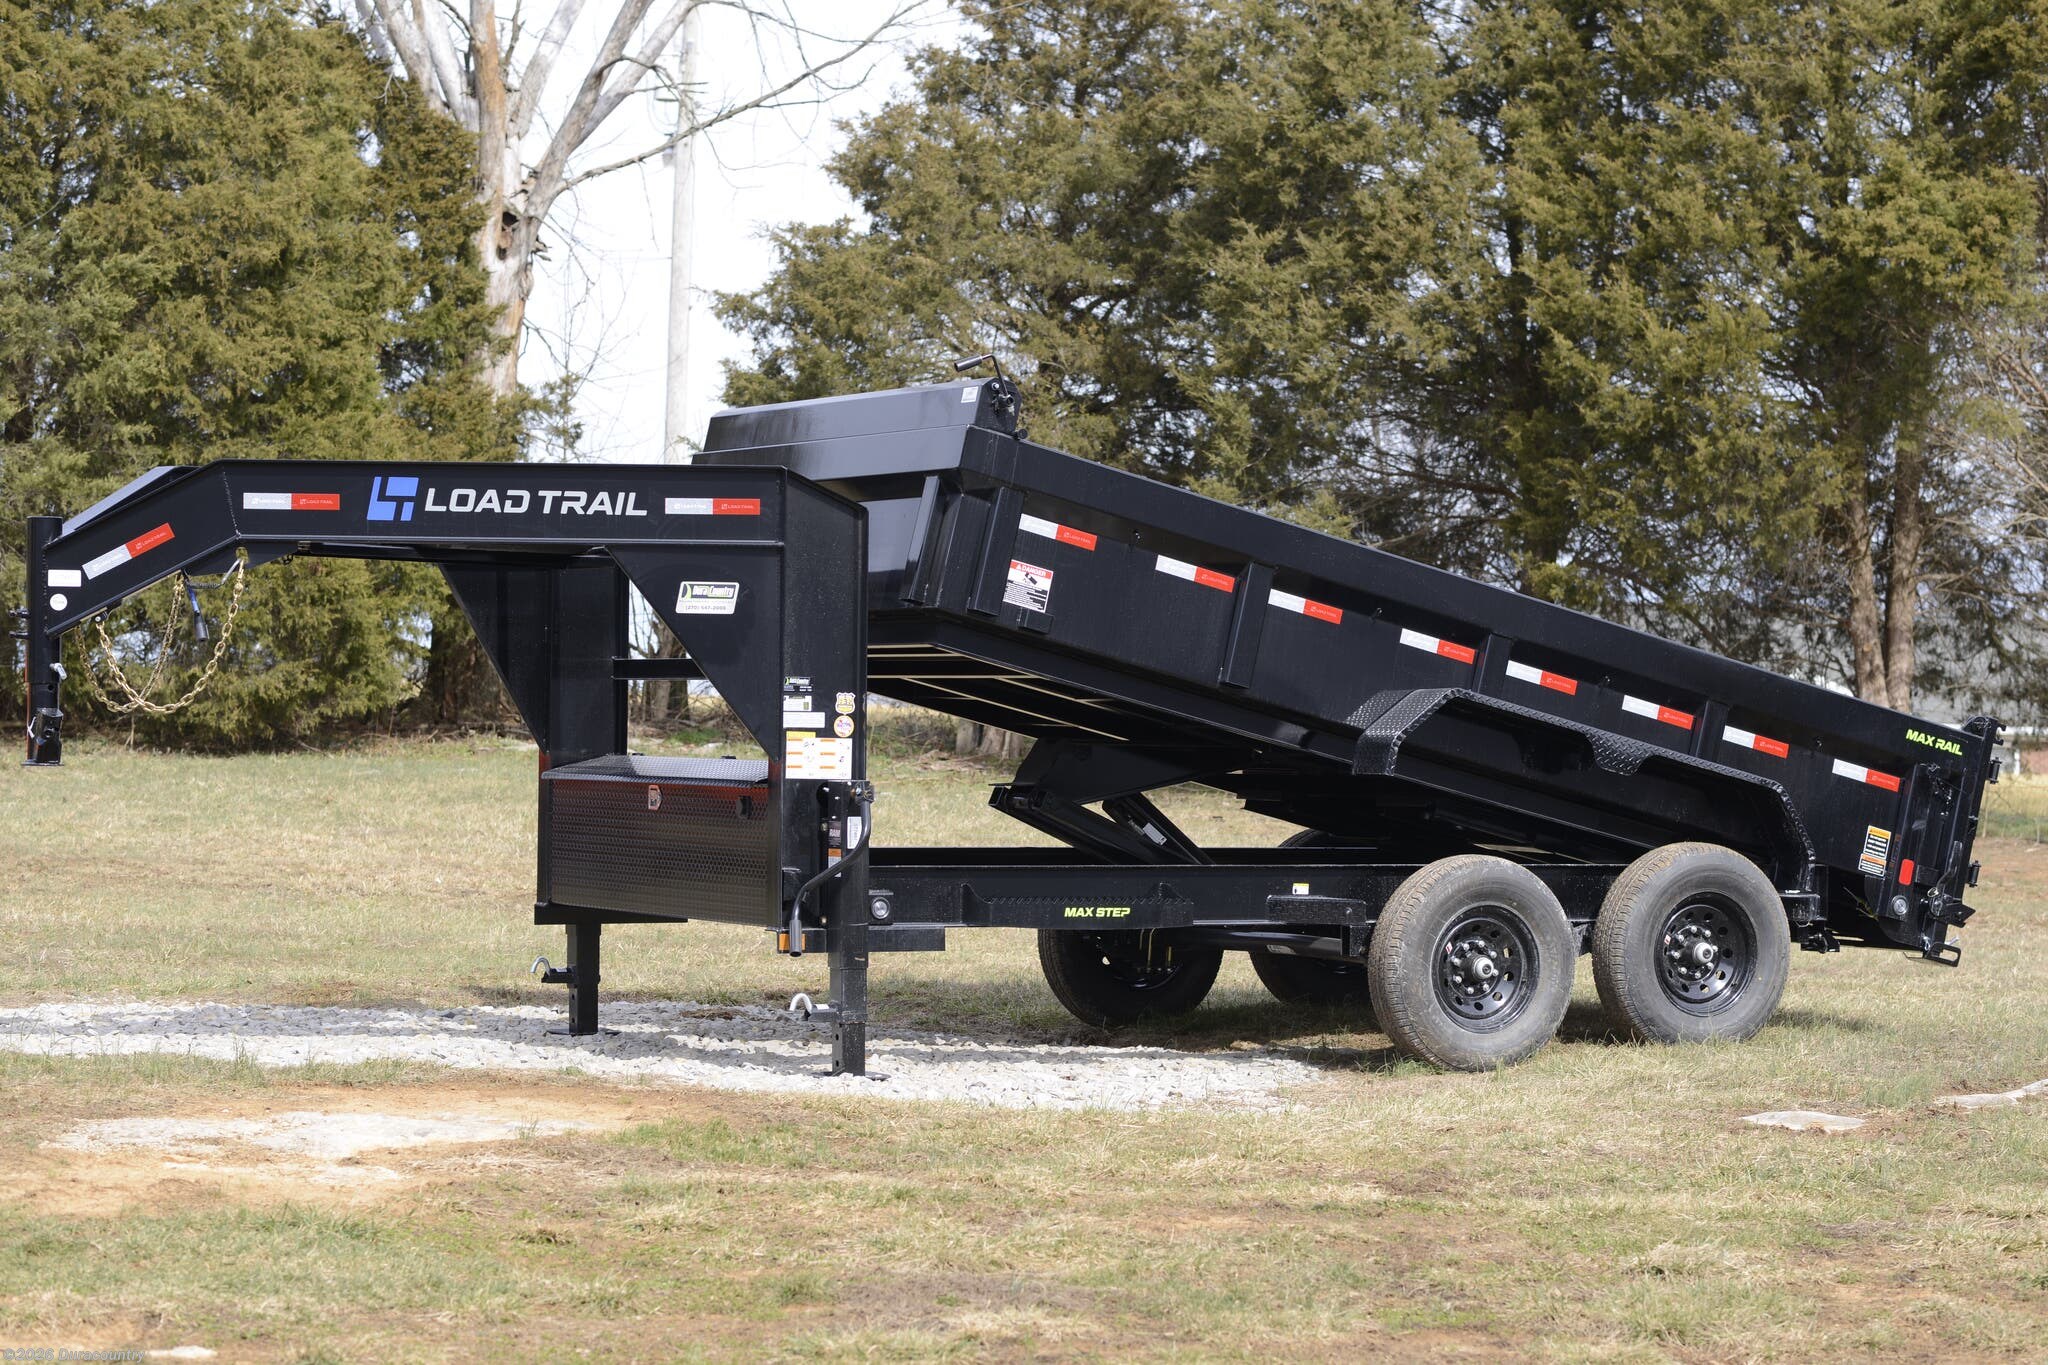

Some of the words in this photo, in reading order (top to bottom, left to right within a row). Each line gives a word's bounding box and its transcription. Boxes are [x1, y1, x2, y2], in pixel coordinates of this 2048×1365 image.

[425, 488, 531, 513] LOAD
[538, 490, 648, 516] TRAIL
[1906, 729, 1935, 748] MAX
[1935, 739, 1963, 755] RAIL
[1064, 907, 1094, 917] MAX
[1095, 907, 1131, 917] STEP
